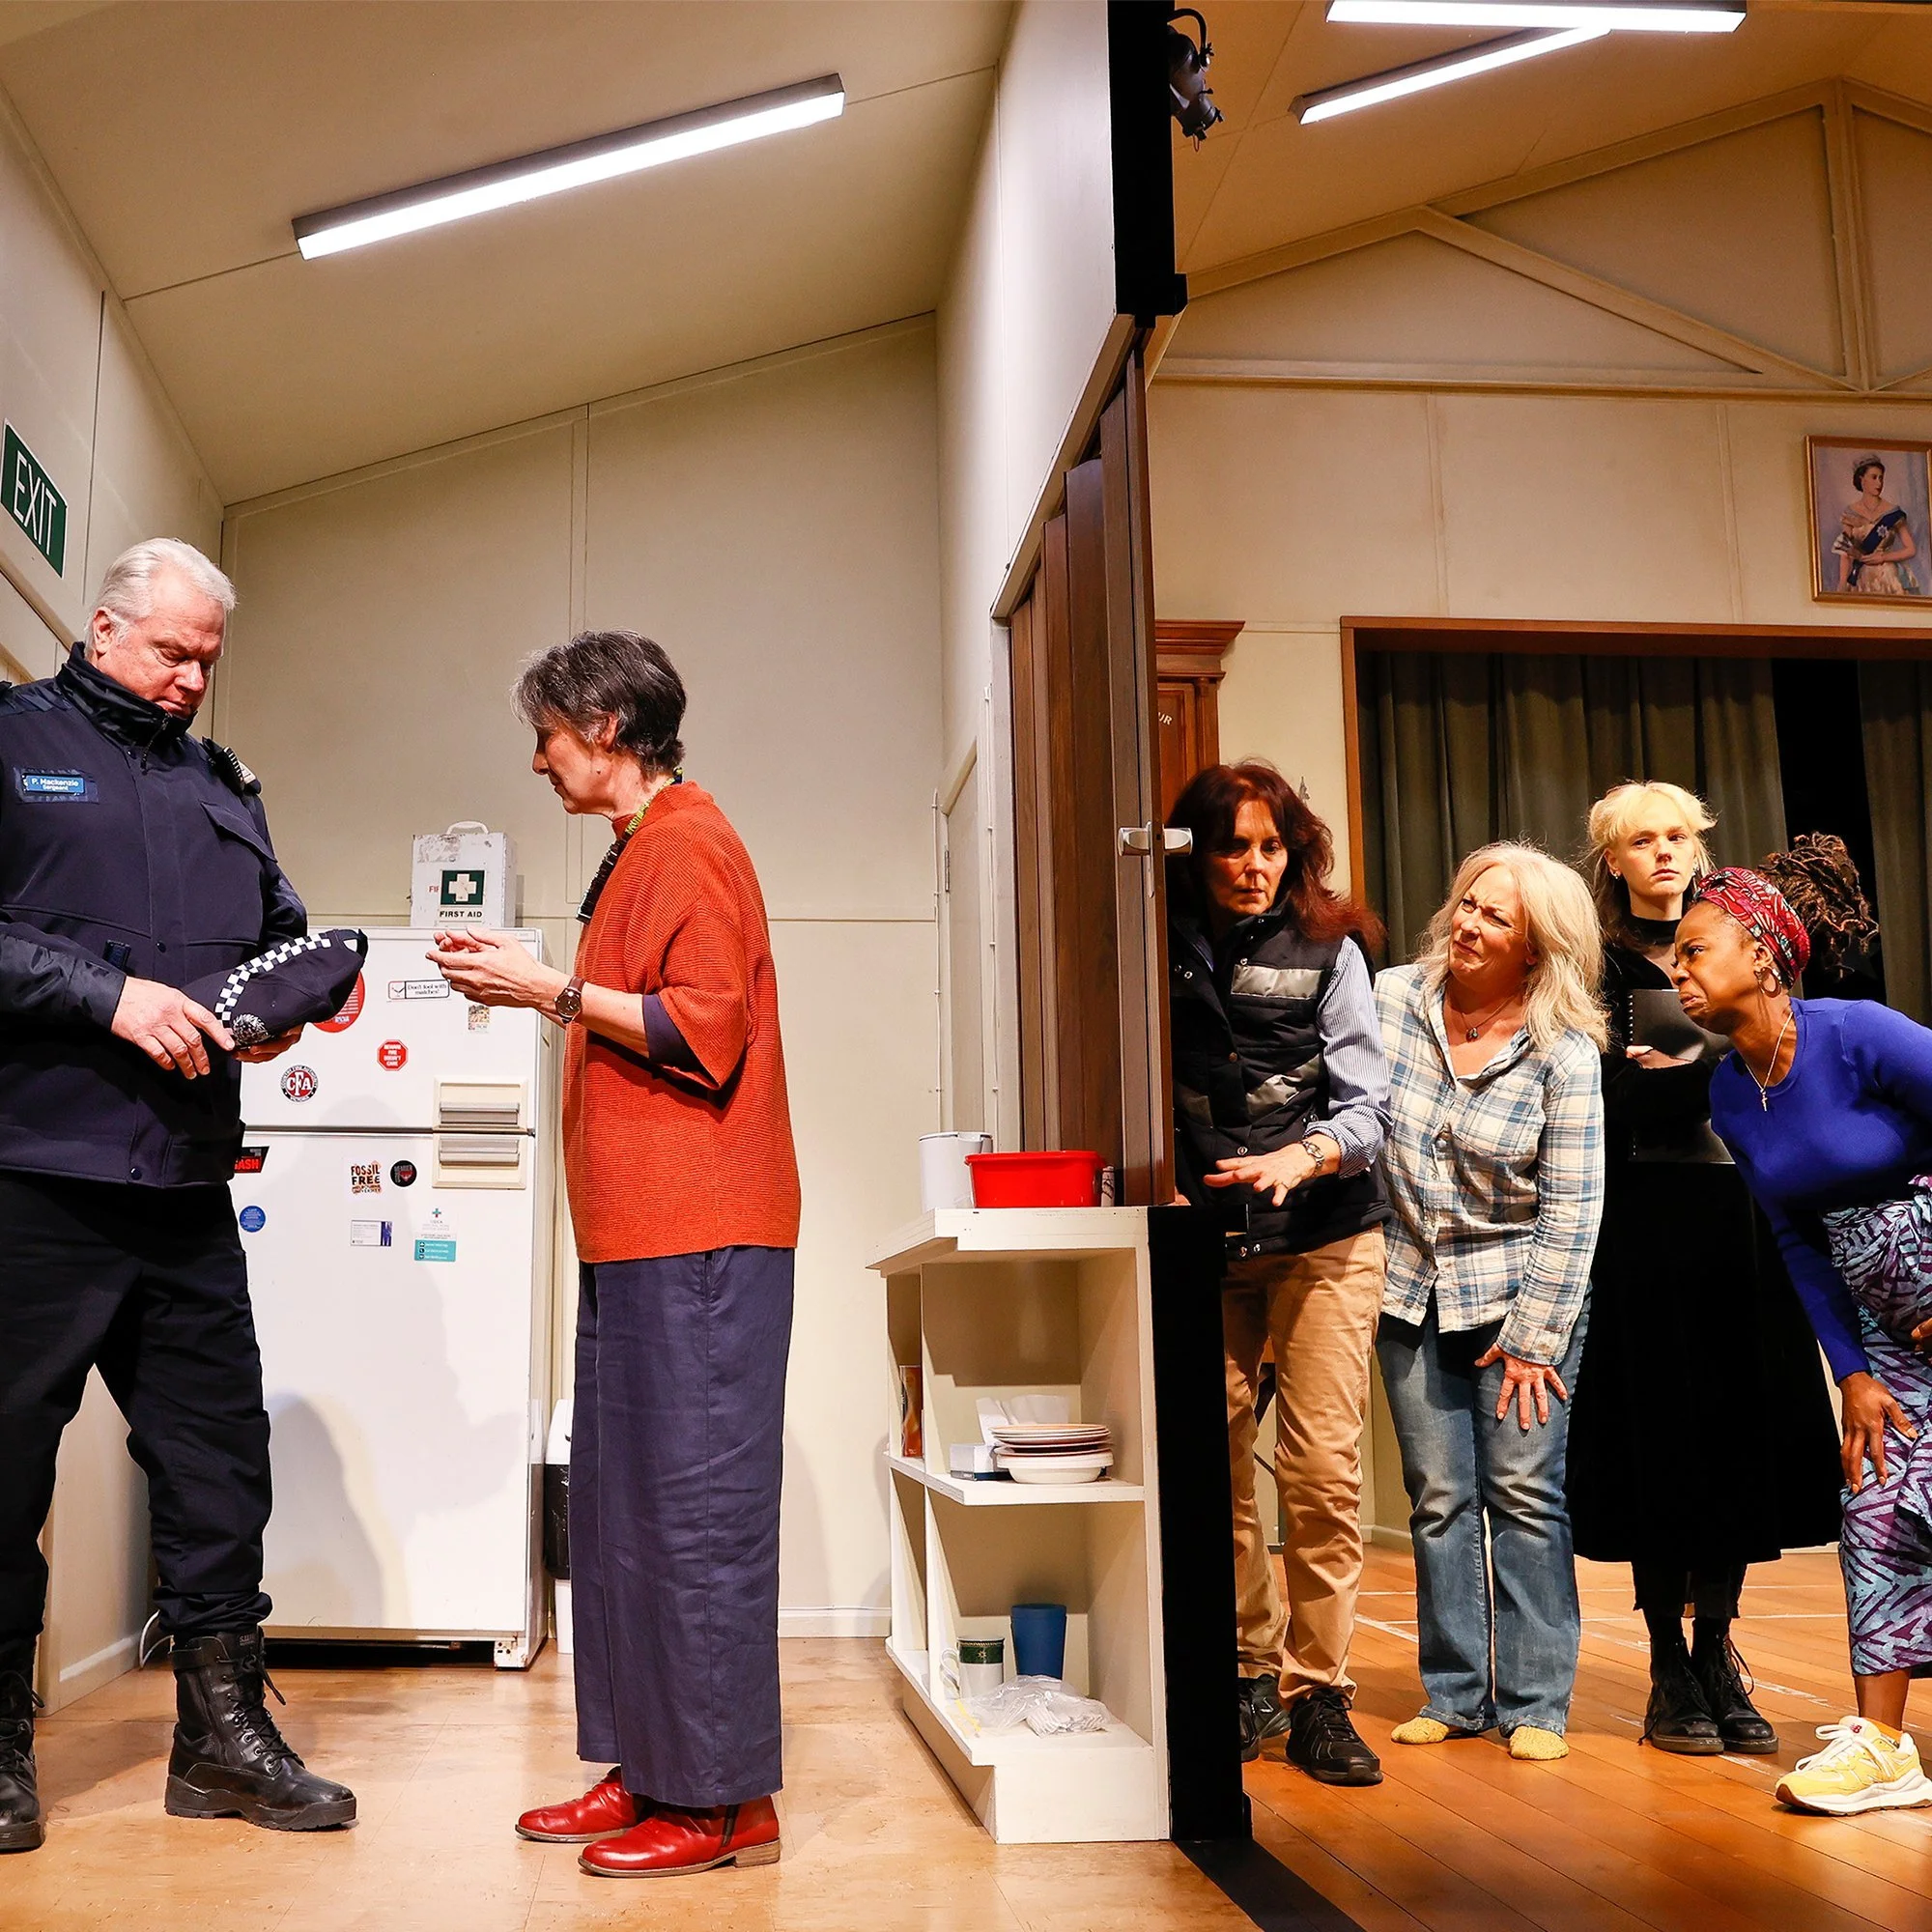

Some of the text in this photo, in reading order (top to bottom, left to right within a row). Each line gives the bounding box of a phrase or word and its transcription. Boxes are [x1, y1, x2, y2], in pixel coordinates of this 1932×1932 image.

[14, 450, 57, 555] EXIT
[40, 779, 79, 787] Mackenzie
[286, 1071, 313, 1096] CFA
[351, 1164, 381, 1176] FOSSIL
[352, 1176, 381, 1185] FREE
